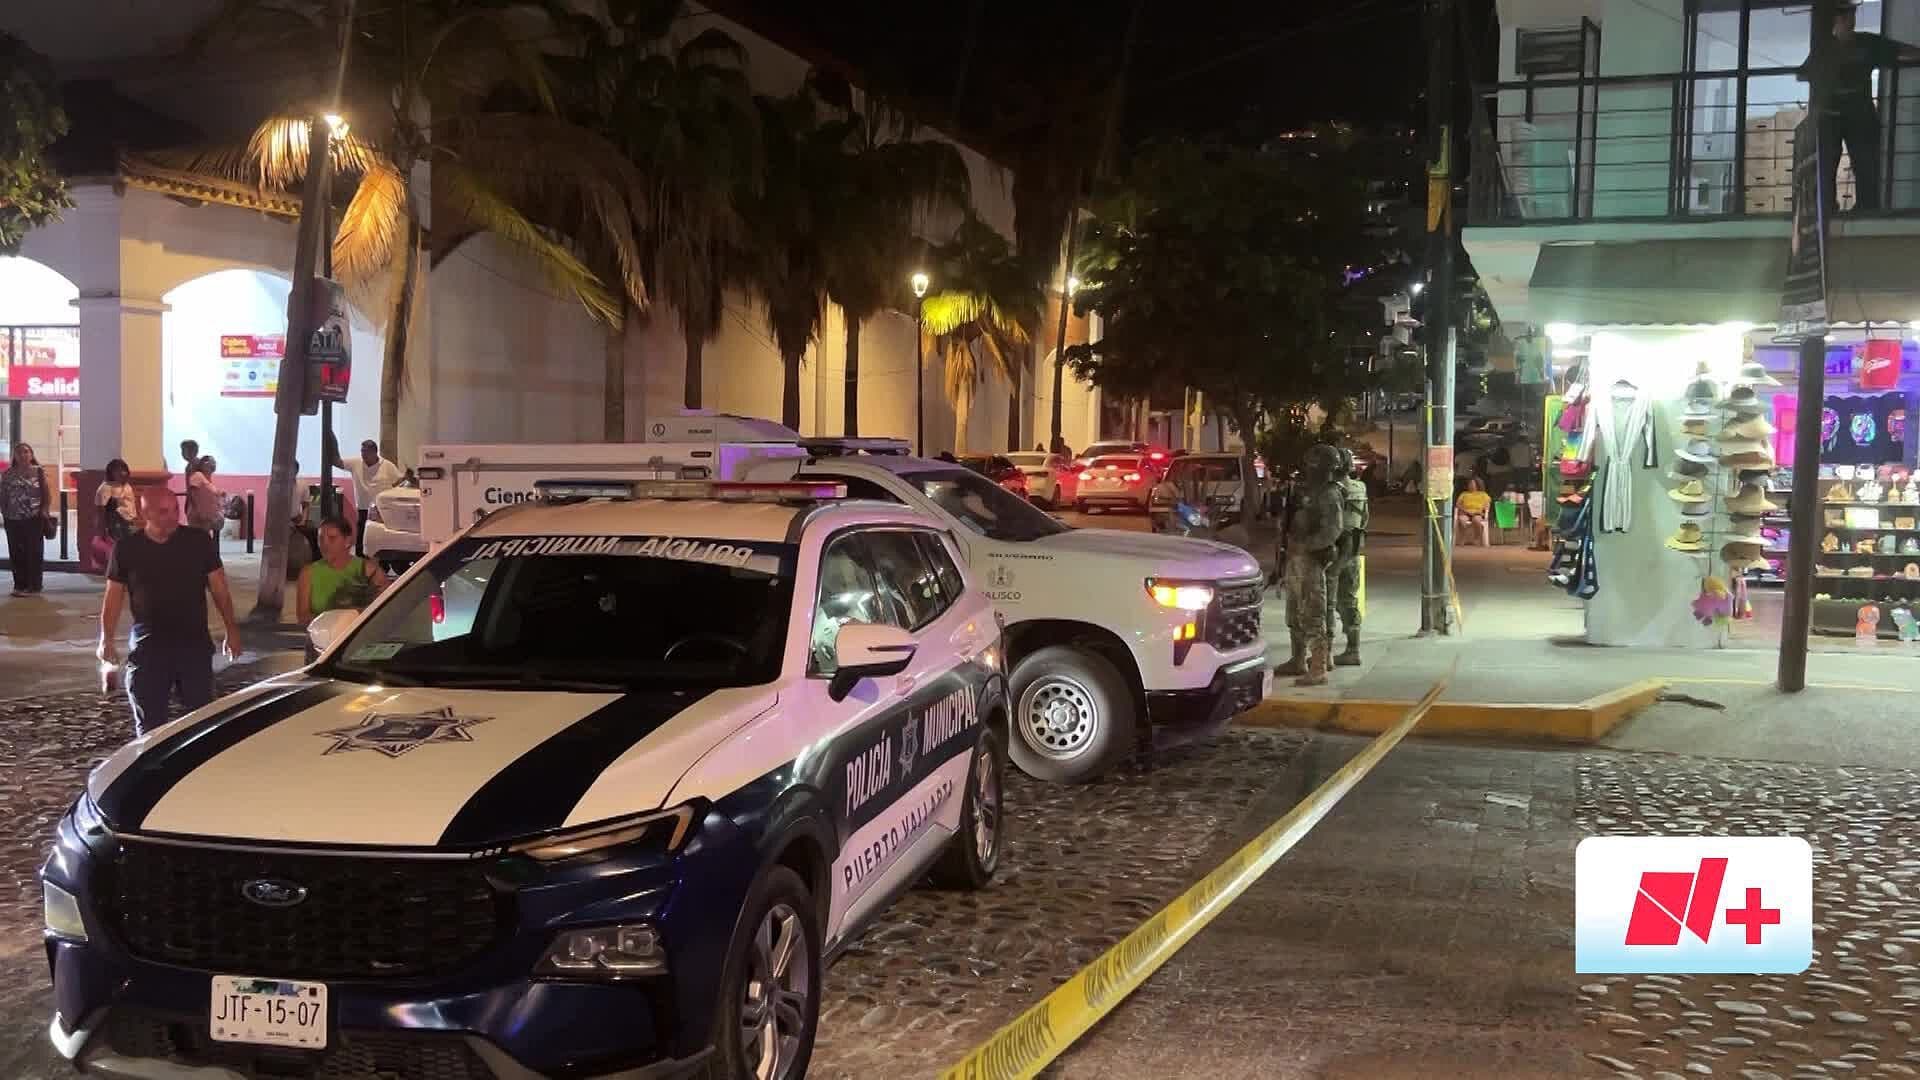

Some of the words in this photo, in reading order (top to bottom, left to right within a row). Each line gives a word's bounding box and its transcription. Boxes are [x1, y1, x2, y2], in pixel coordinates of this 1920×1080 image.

[27, 376, 80, 395] Salid
[484, 487, 540, 504] Cienc
[981, 591, 1022, 600] ALISCO
[846, 729, 892, 816] POLICÍA
[922, 684, 979, 756] MUNICIPAL
[844, 826, 898, 892] PUERTO
[216, 994, 321, 1027] JTF-15-07
